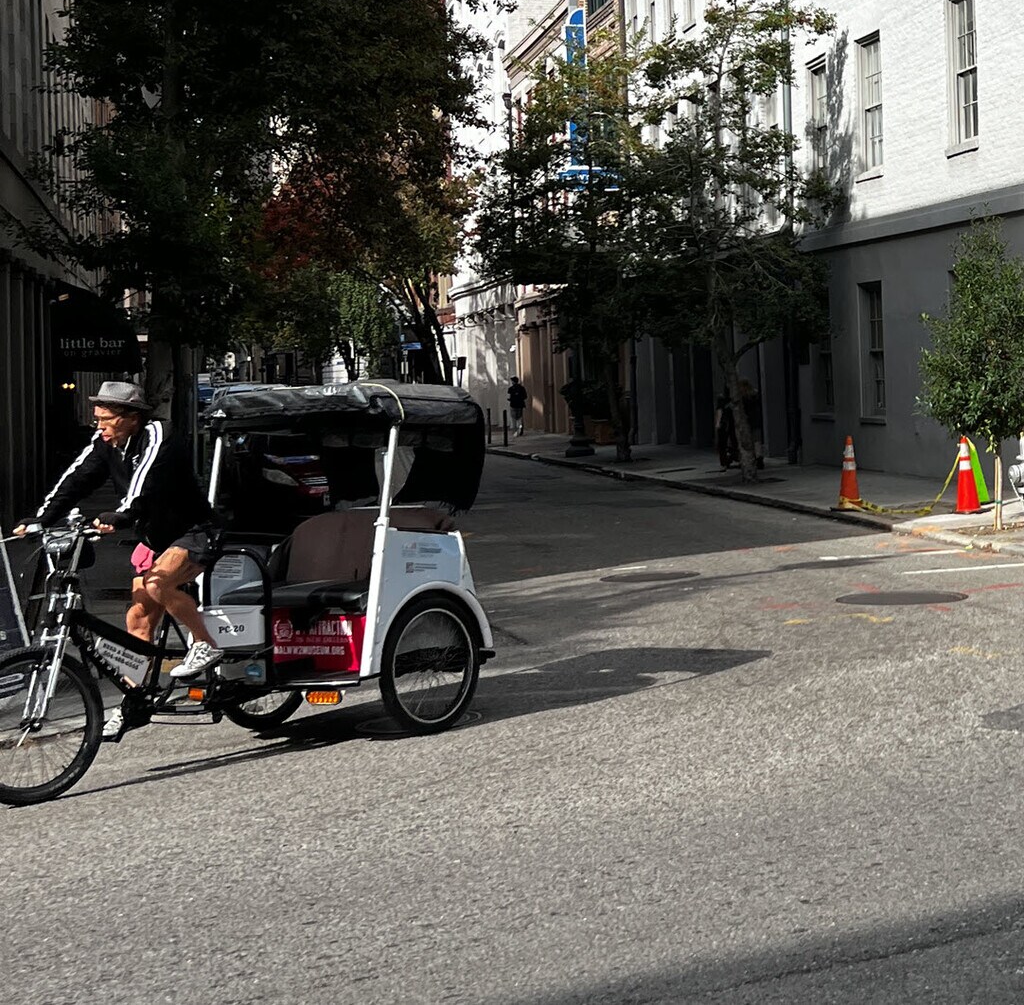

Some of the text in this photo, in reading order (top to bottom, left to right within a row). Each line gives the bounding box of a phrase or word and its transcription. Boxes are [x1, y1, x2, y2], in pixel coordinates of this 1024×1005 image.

[60, 337, 126, 349] little bar
[81, 349, 122, 358] gravier
